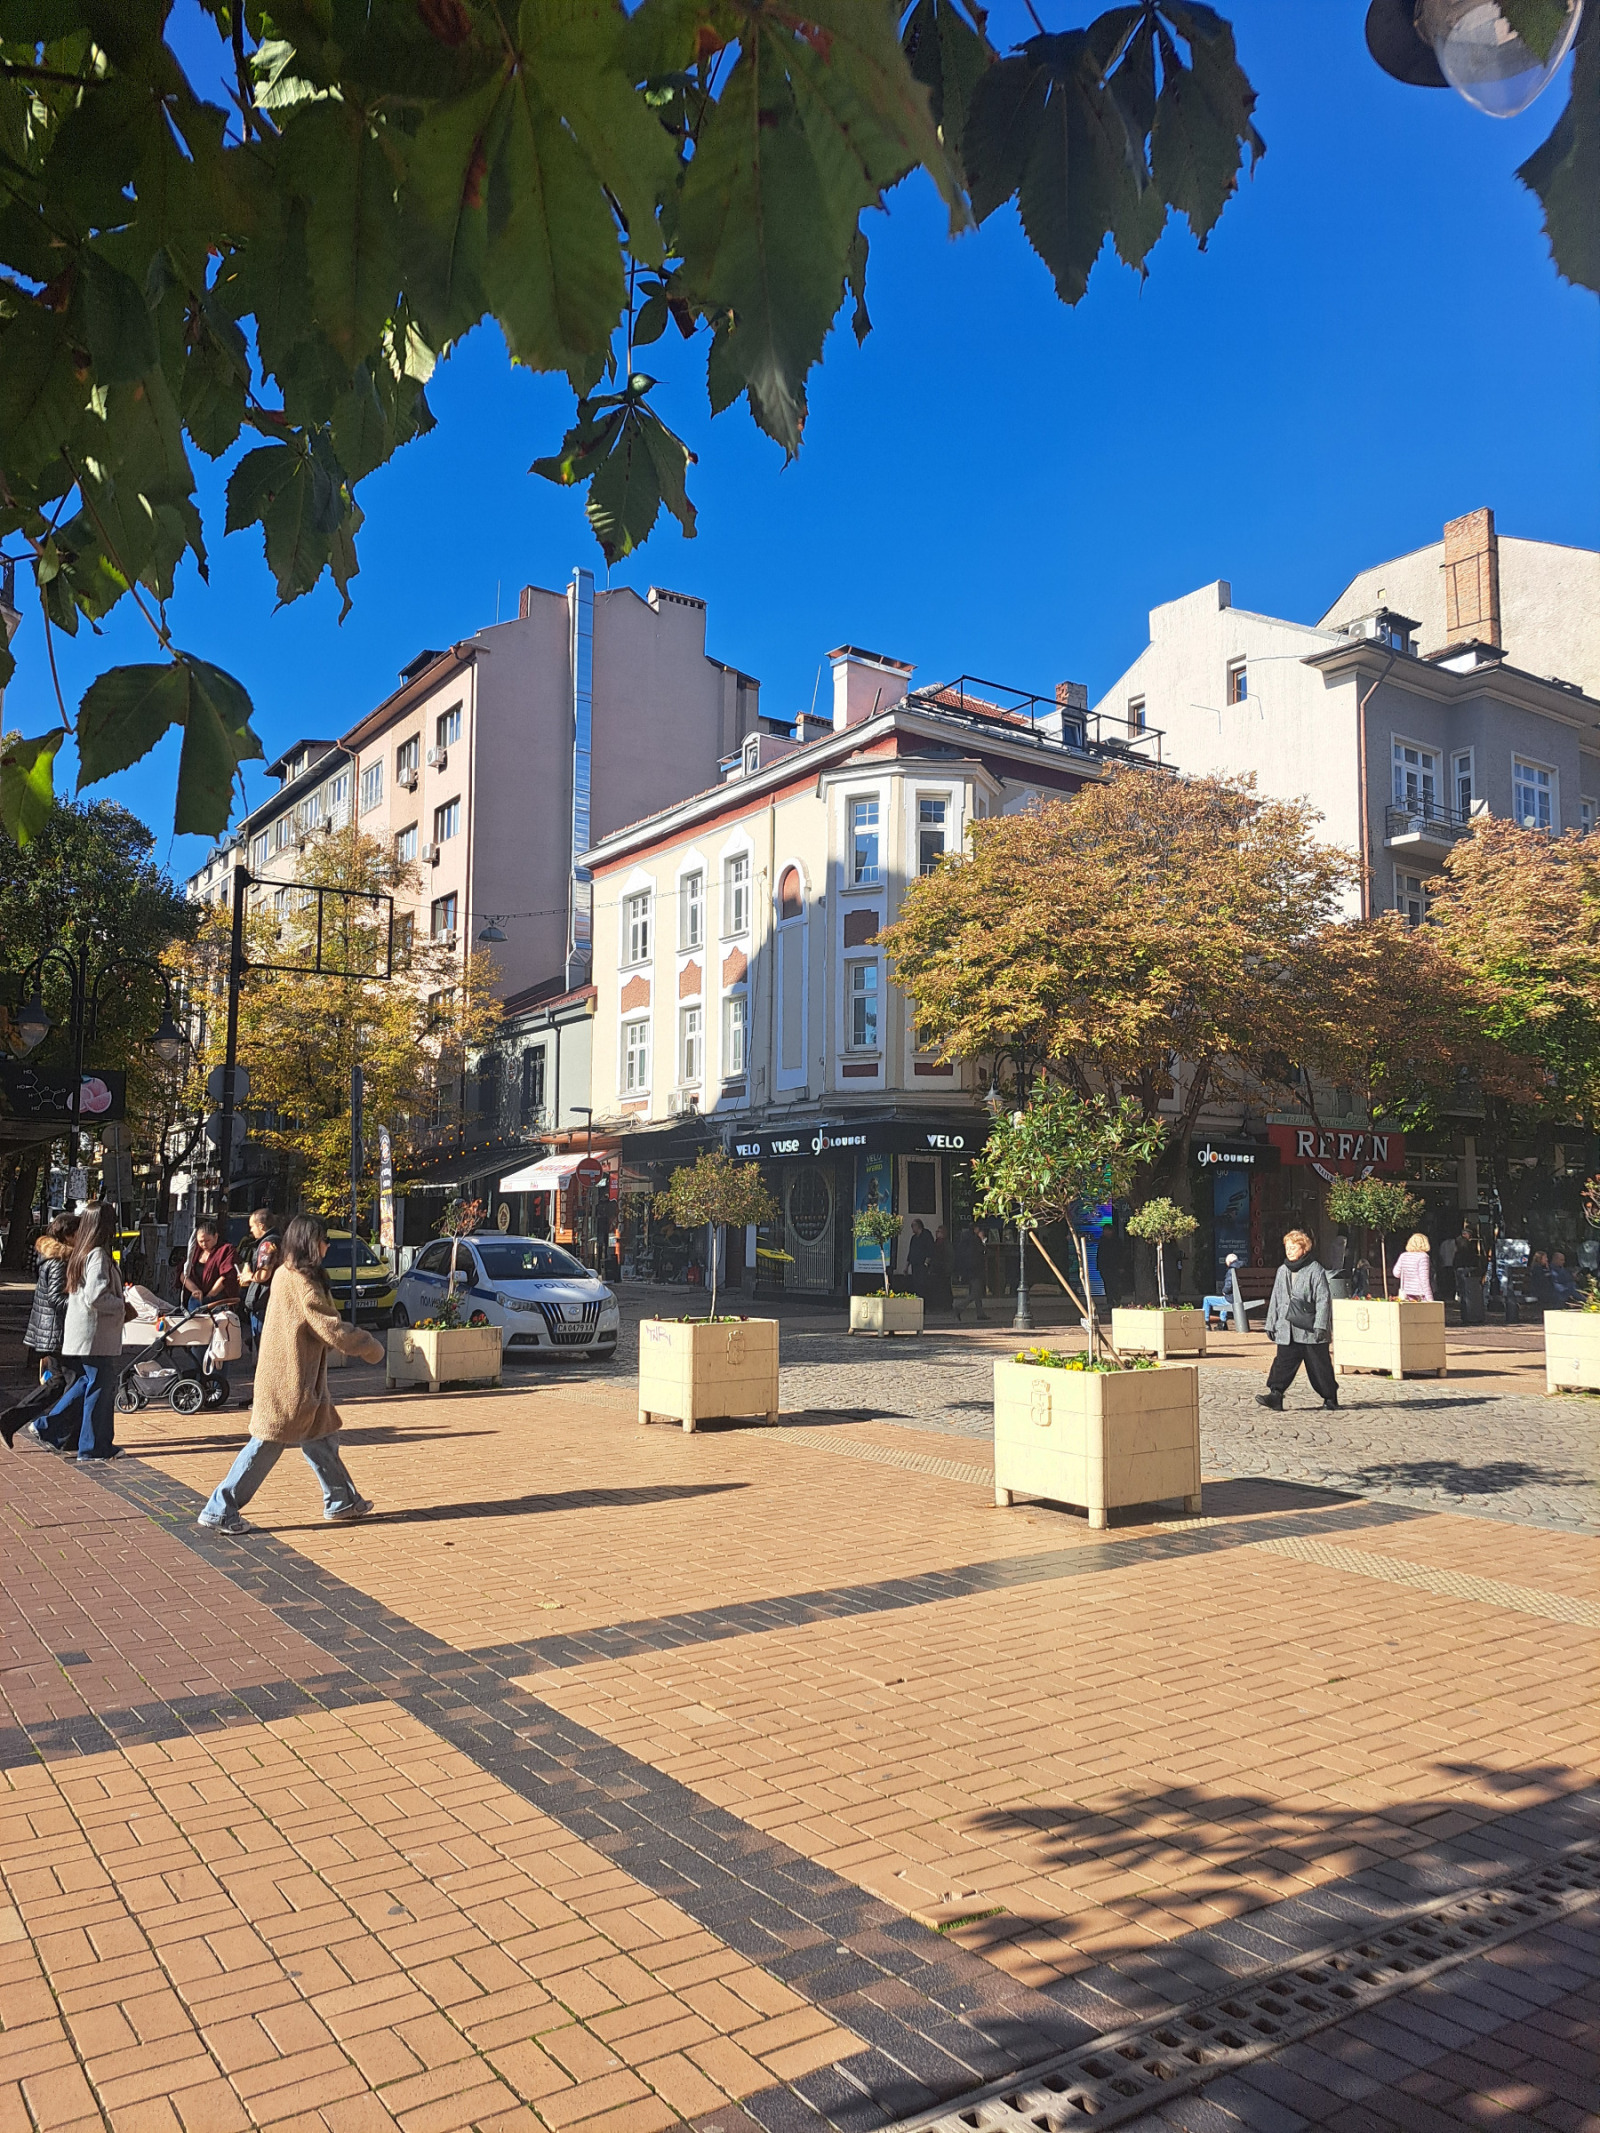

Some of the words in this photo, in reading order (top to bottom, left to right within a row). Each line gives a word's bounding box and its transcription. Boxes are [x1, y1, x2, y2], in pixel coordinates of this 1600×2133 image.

[830, 1135, 867, 1147] LOUNGE
[926, 1134, 965, 1149] VELO
[1296, 1130, 1389, 1162] REFAN
[735, 1143, 761, 1156] VELO
[1218, 1153, 1255, 1164] LOUNGE
